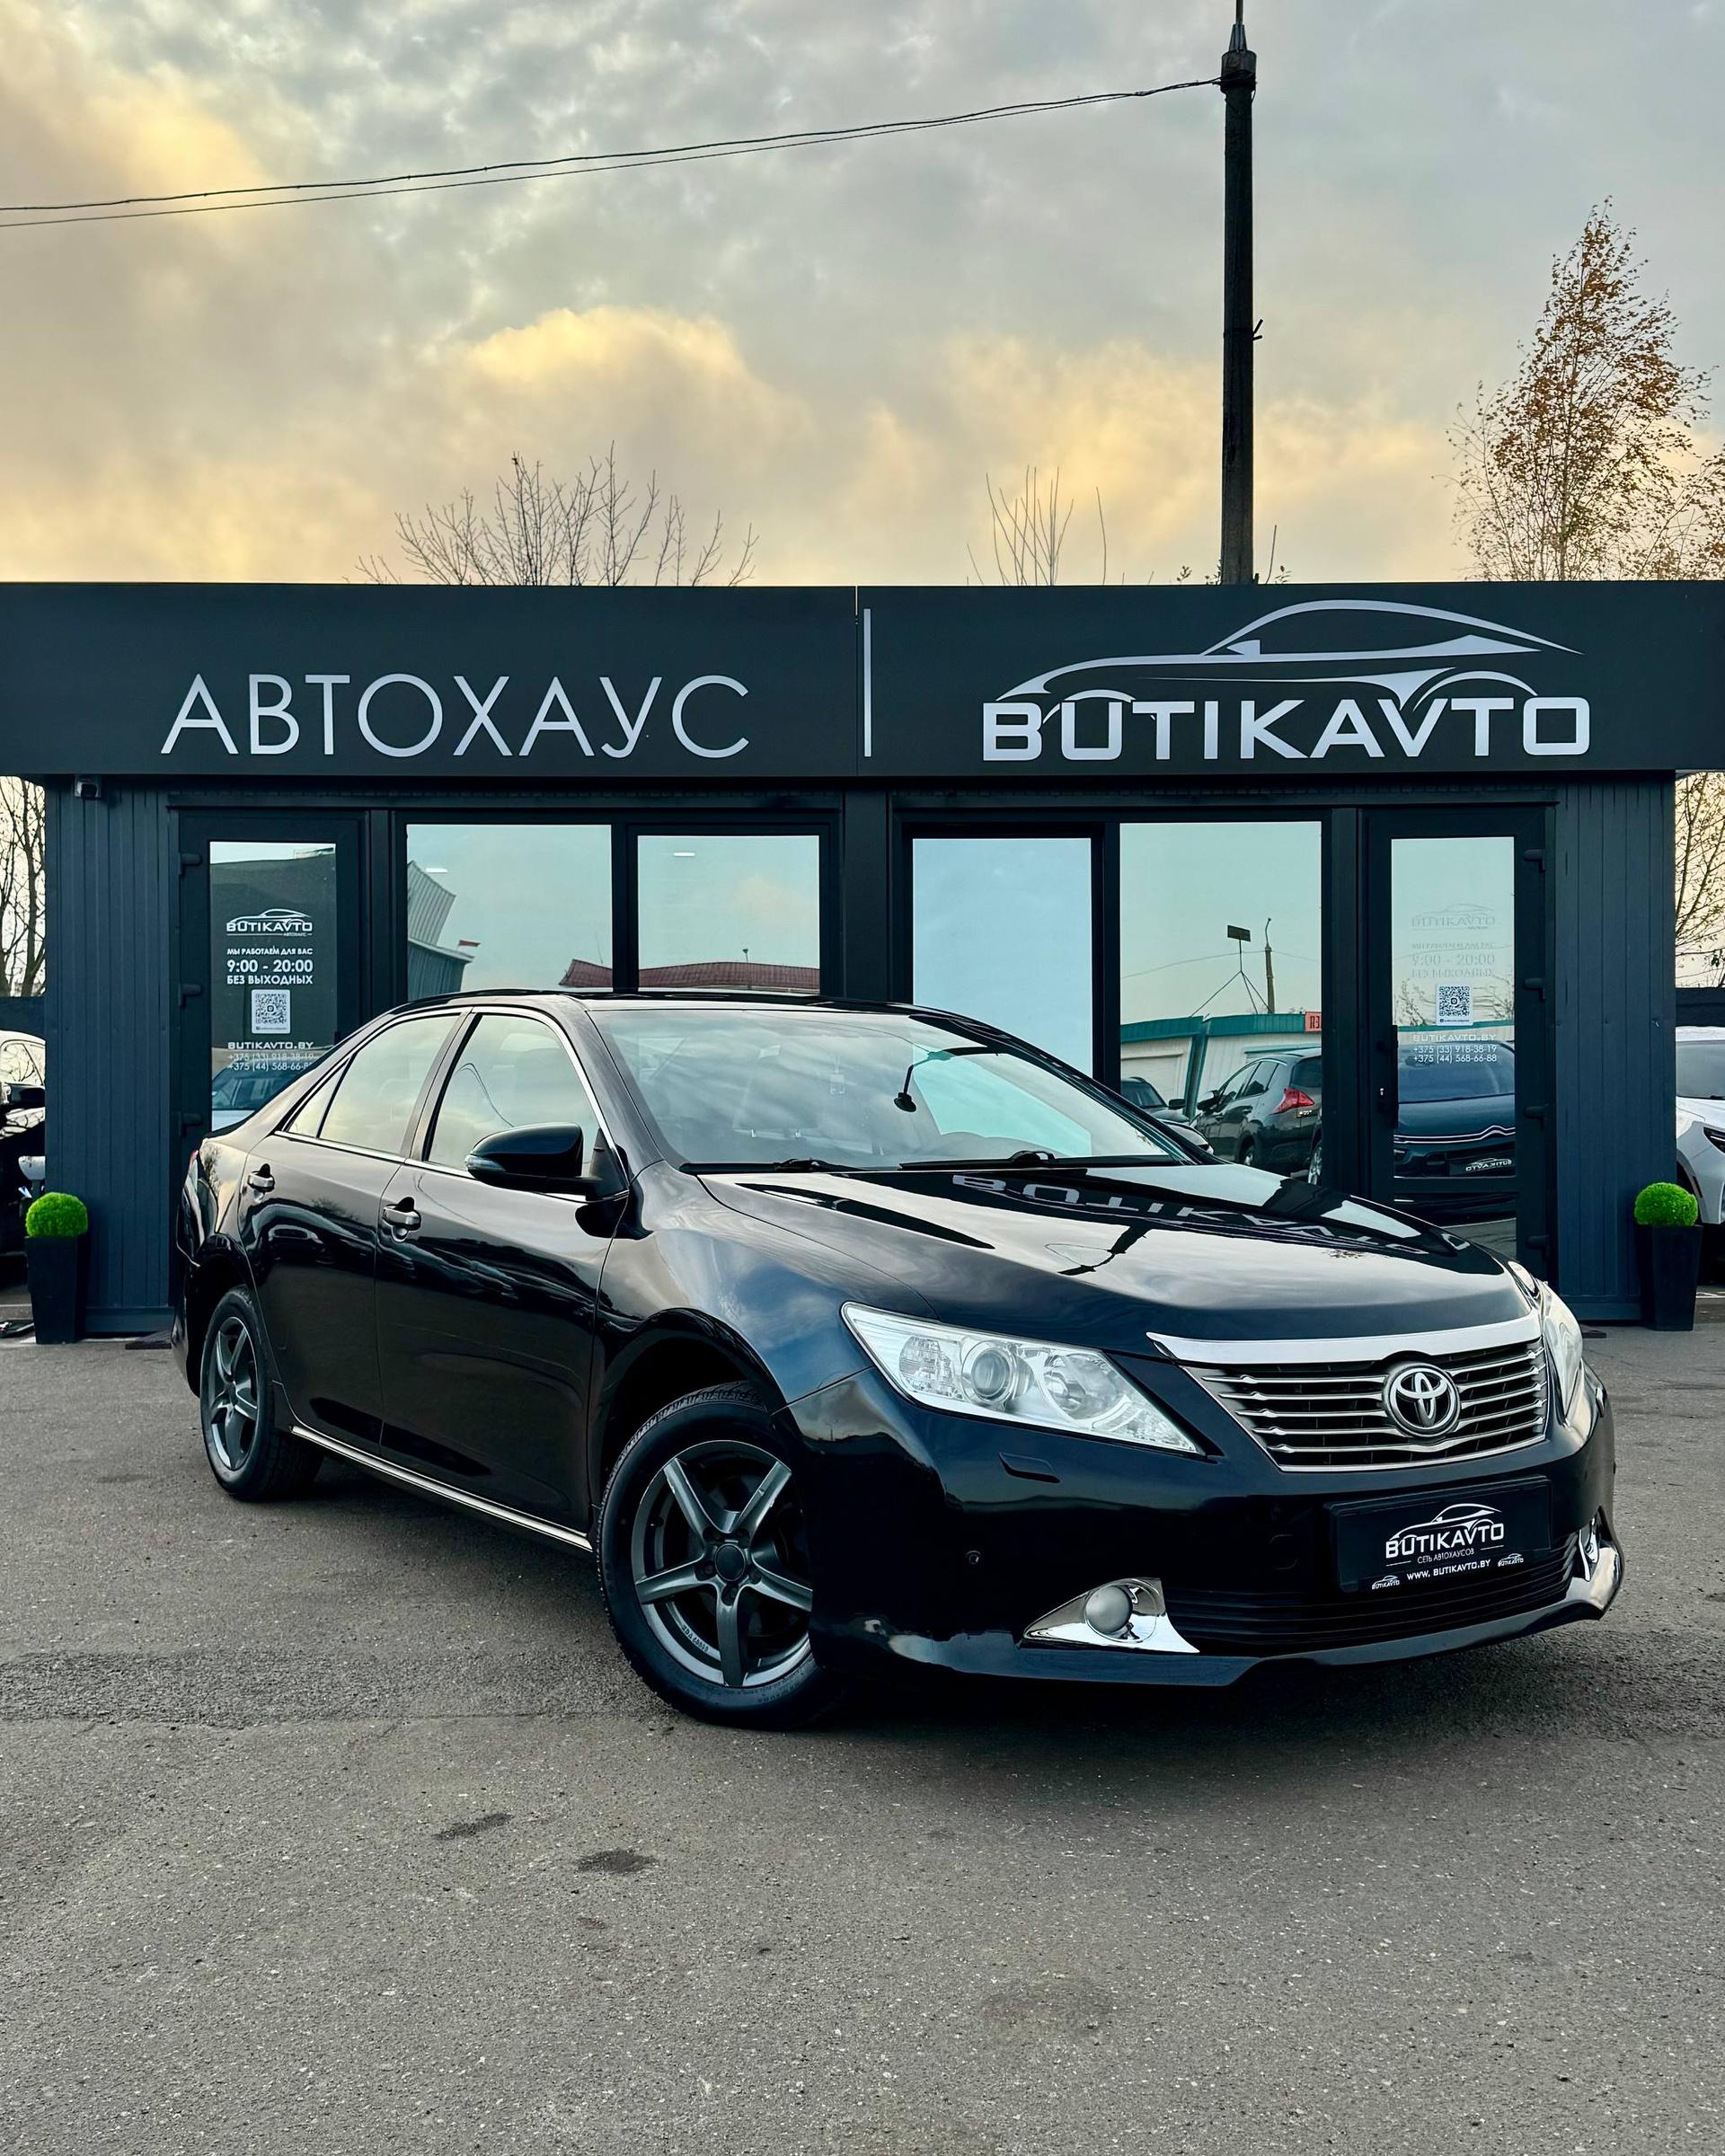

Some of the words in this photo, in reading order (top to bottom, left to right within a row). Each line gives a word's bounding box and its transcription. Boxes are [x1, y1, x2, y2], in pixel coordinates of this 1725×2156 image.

[160, 673, 750, 759] АВТОХАУС
[982, 696, 1590, 762] BUTIKAVTO
[226, 922, 313, 932] BUTIKAVTO
[280, 948, 296, 956] ДЛЯ
[226, 959, 259, 973] 9:00
[272, 959, 314, 973] 20:00
[226, 975, 245, 985] БЕЗ
[248, 975, 314, 985] ВЫХОДНЫХ
[1412, 1034, 1497, 1042] BUTIKAVTO.BY
[227, 1040, 314, 1049] BUTIKAVTO.BY
[1413, 1045, 1434, 1054] +375
[1436, 1045, 1453, 1055] (33)
[1455, 1045, 1497, 1054] 918-38-19
[1413, 1055, 1434, 1063] +375
[1436, 1055, 1453, 1064] (44)
[1455, 1055, 1498, 1063] 568-66-88
[227, 1062, 250, 1071] +375
[252, 1062, 270, 1072] (44)
[1384, 1523, 1505, 1559] BUTIKAVTO
[1417, 1555, 1433, 1564] СЕТЬ
[1433, 1548, 1475, 1561] АВТОХАУСОВ
[1407, 1569, 1431, 1580] WWW.
[1433, 1559, 1491, 1577] BUTIKAVTO.BY
